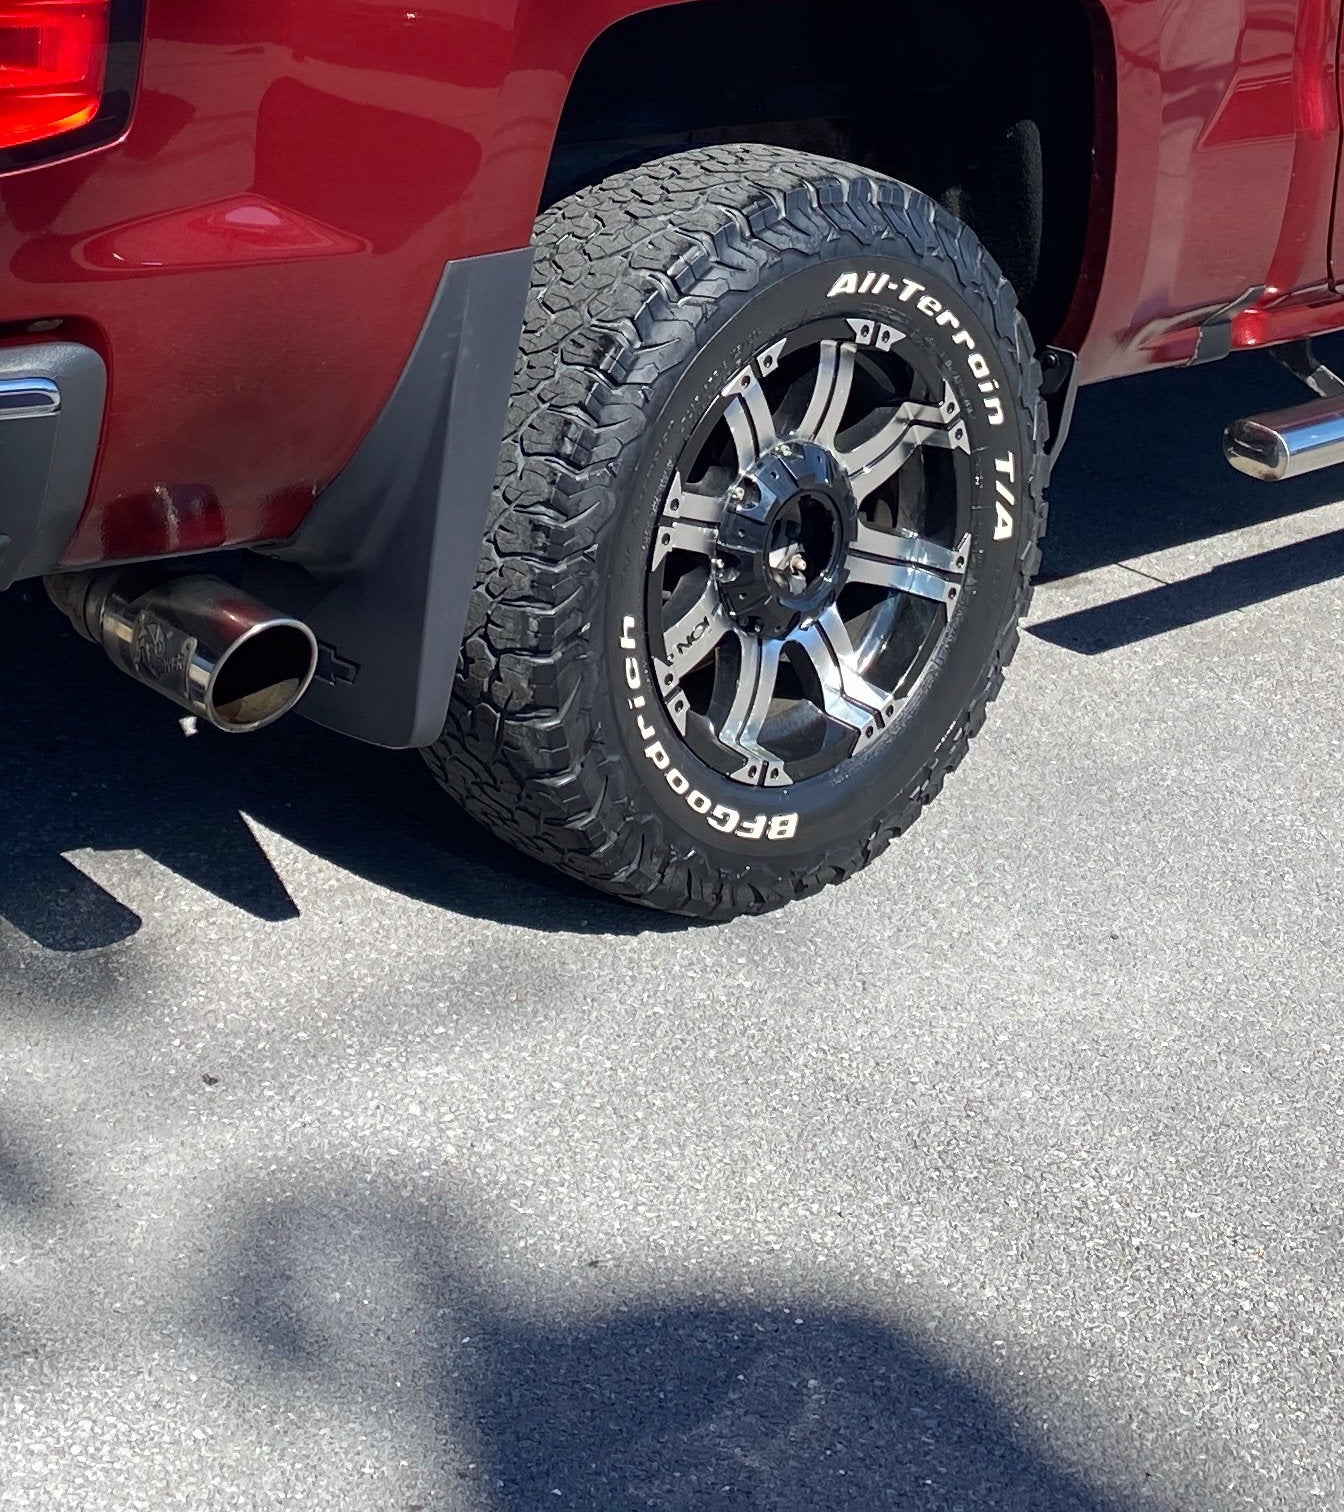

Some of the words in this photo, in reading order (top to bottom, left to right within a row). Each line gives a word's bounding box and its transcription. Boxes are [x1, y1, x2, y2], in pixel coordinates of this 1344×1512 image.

[825, 270, 1005, 426] All-Terrain
[992, 449, 1015, 541] T/A
[619, 614, 800, 841] BFGoodrich
